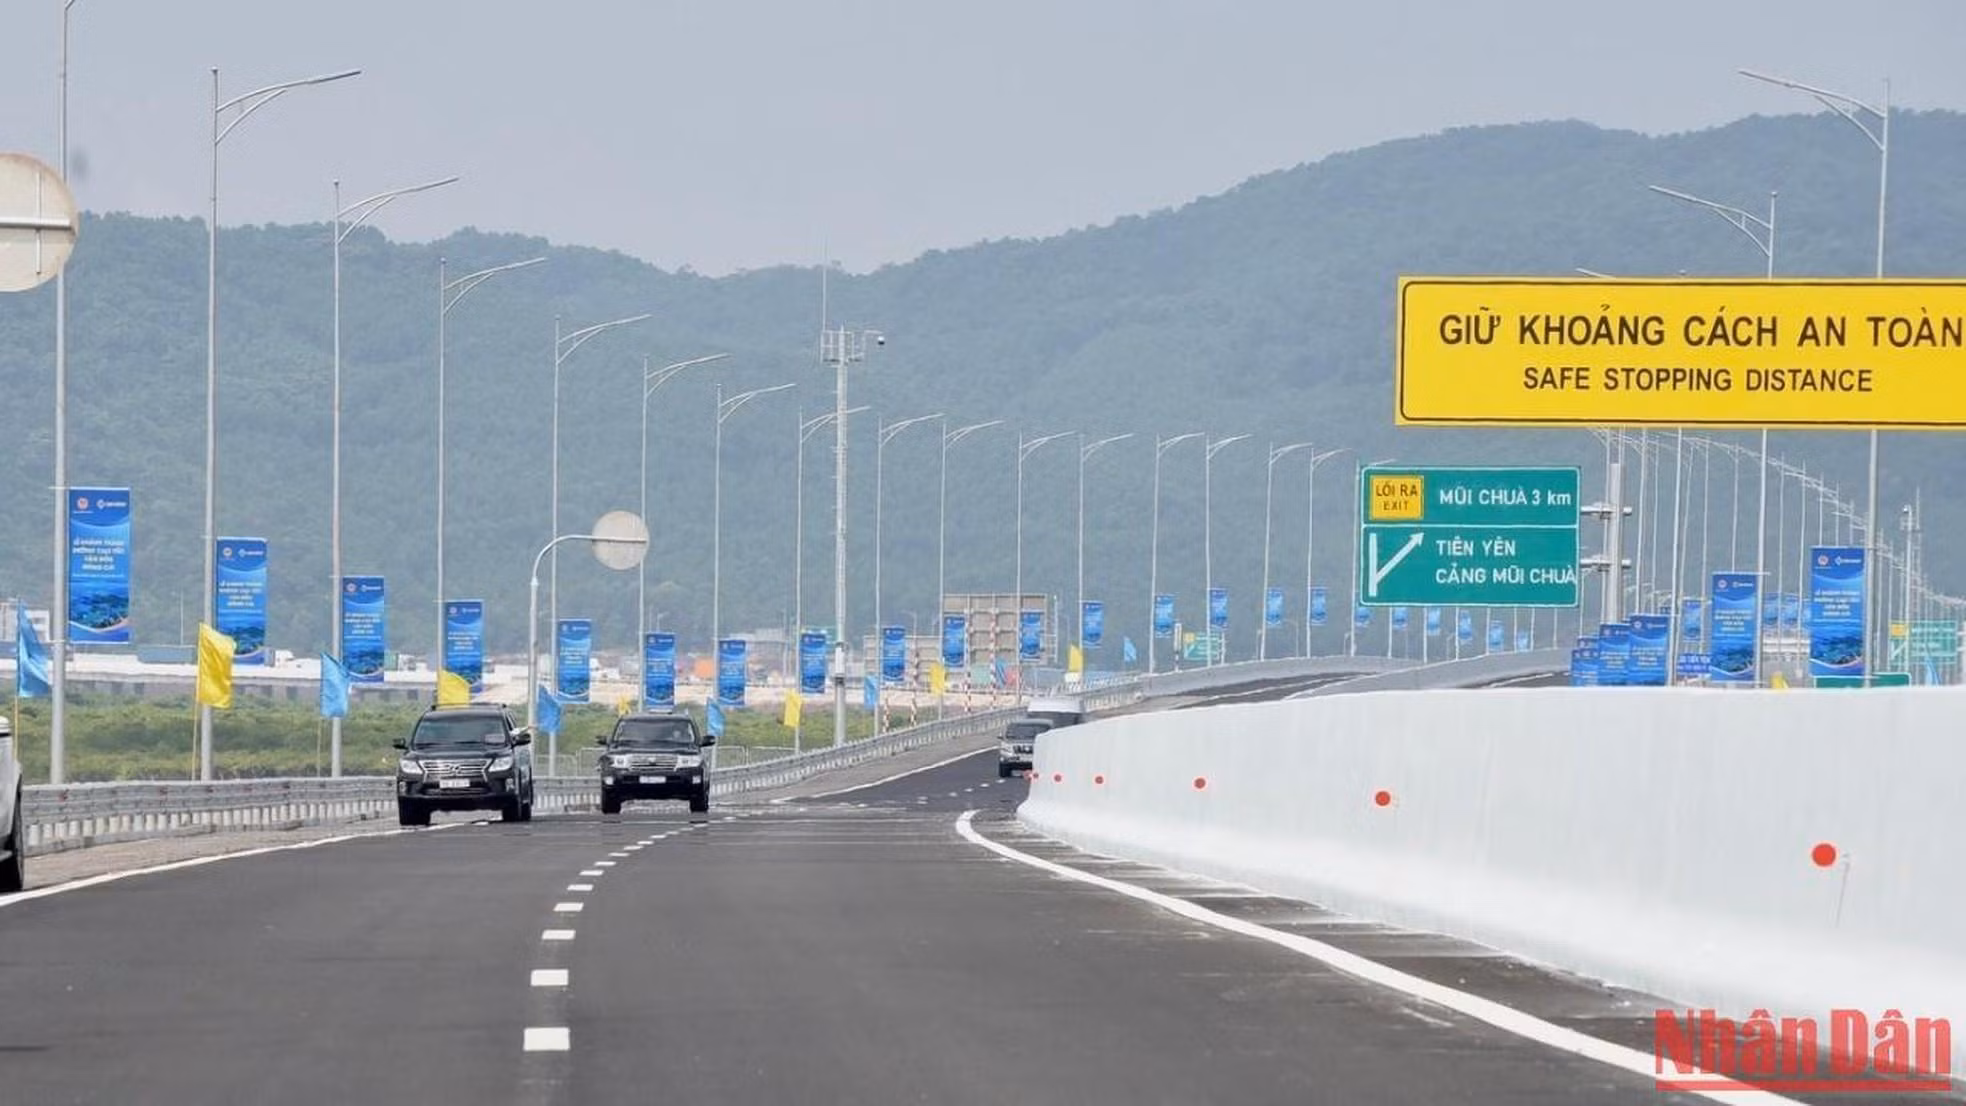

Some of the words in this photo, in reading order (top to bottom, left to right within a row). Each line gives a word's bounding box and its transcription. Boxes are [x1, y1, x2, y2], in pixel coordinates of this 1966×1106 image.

[1440, 306, 1500, 345] GIỮ
[1519, 304, 1665, 346] KHOẢNG
[1684, 306, 1777, 347] CÁCH
[1797, 316, 1846, 347] AN
[1866, 307, 1962, 348] TOÀN
[1523, 367, 1590, 390] SAFE
[1604, 367, 1732, 391] STOPPING
[1746, 369, 1872, 391] DISTANCE
[1400, 484, 1418, 497] RA
[1440, 486, 1472, 505] MŨI
[1532, 489, 1541, 505] 3
[1547, 489, 1571, 505] km
[1383, 500, 1408, 511] EXIT
[1436, 536, 1474, 556] TIÊN
[1482, 536, 1516, 556] YÊN
[1436, 563, 1486, 585] CẢNG
[1493, 565, 1524, 585] MŨI
